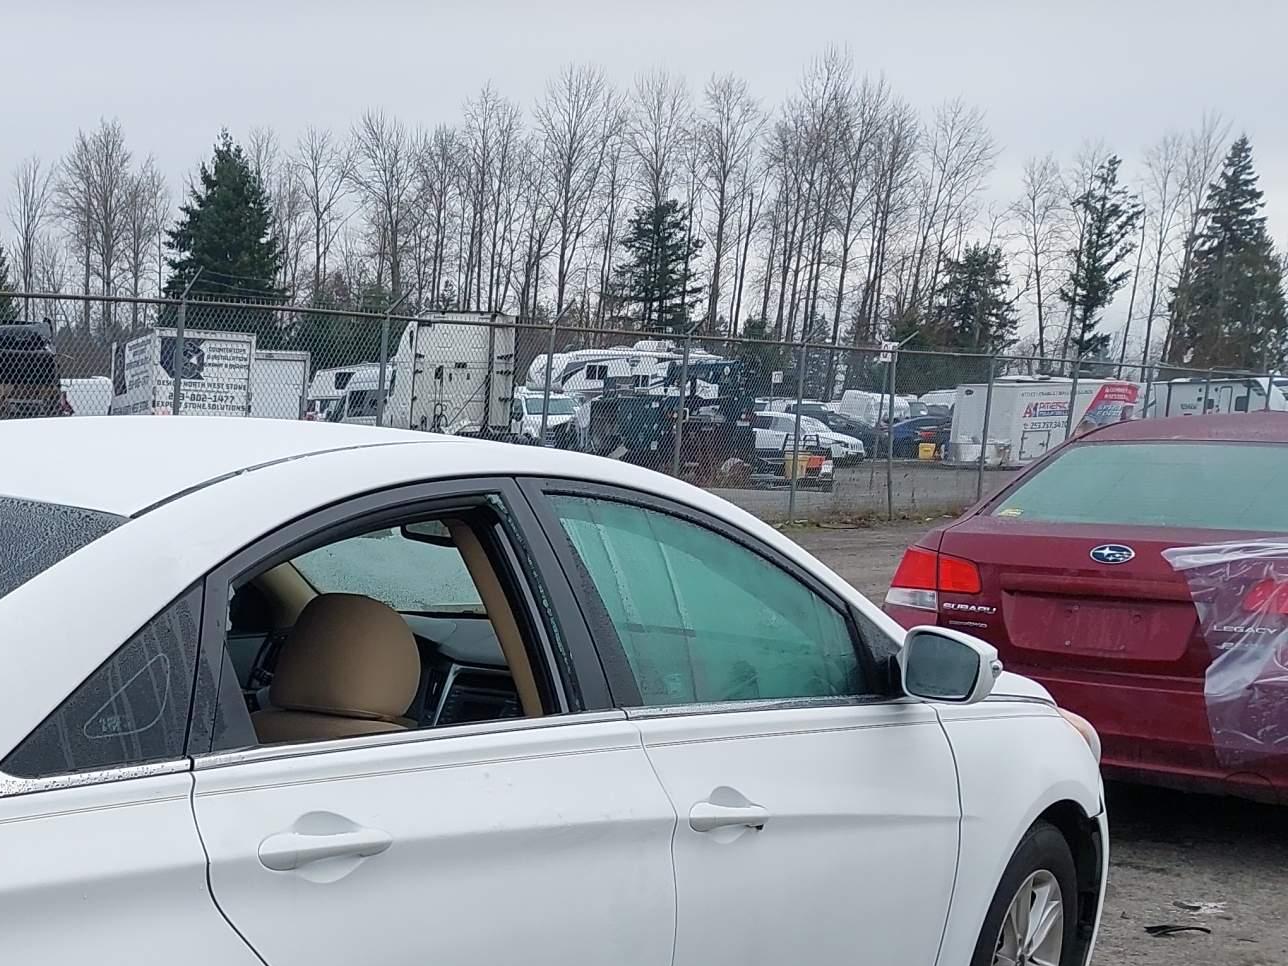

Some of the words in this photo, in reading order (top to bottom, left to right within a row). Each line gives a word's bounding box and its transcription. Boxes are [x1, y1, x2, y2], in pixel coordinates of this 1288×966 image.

[226, 383, 247, 391] STONE
[168, 393, 235, 403] 23-802-1477
[208, 403, 246, 411] SOLUTIONS
[943, 602, 997, 614] SUBARU
[1213, 625, 1277, 634] LEGACY
